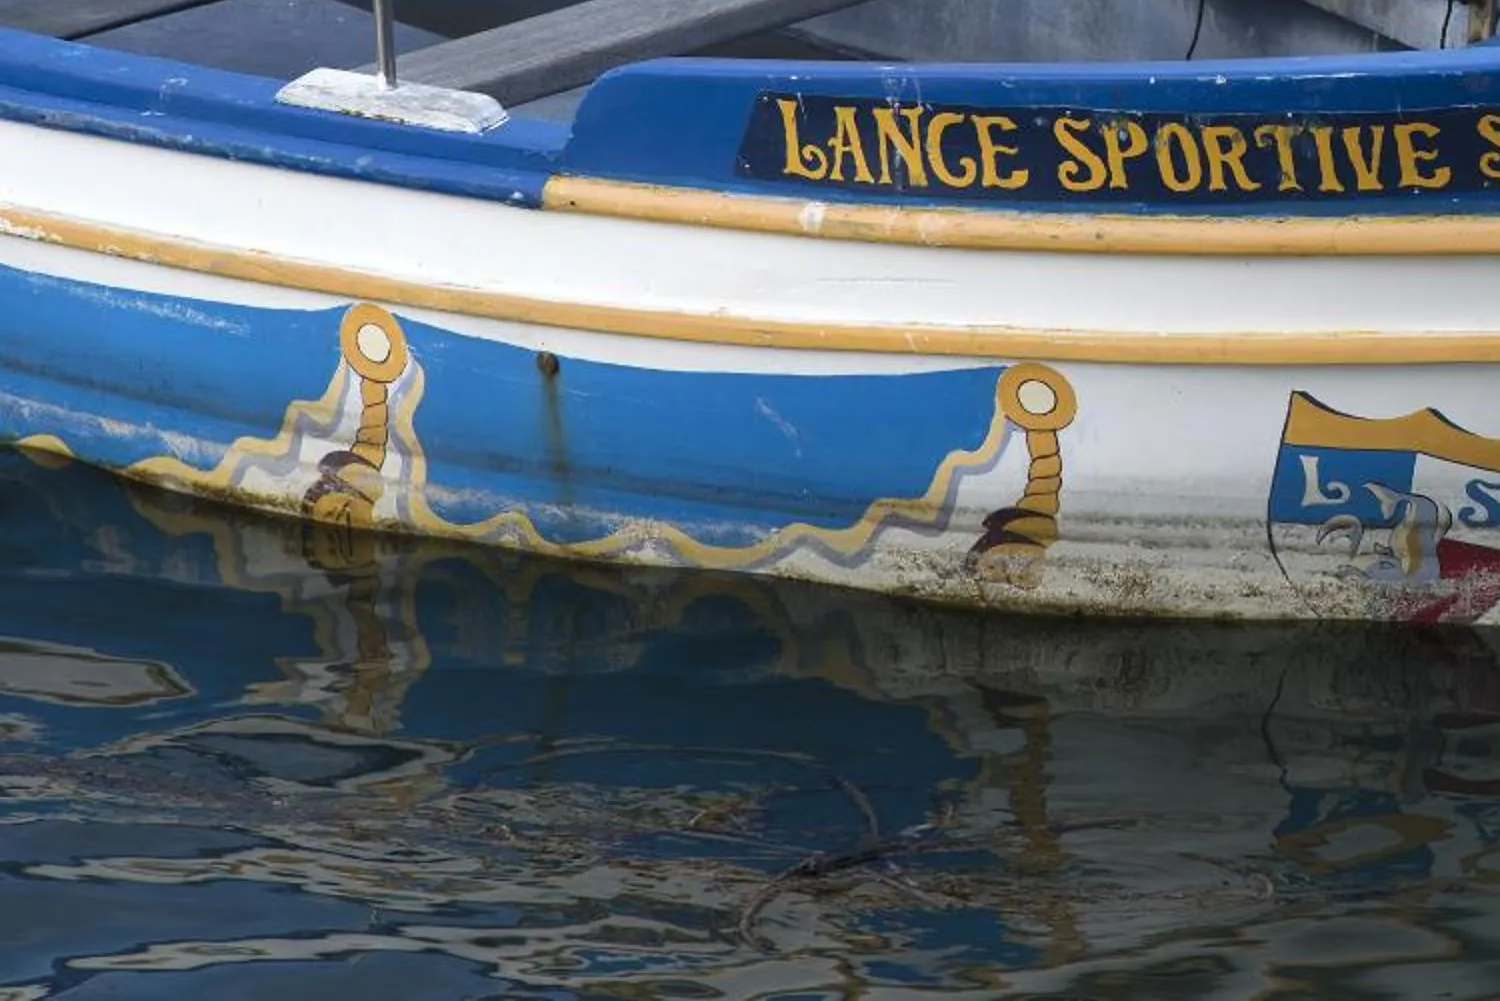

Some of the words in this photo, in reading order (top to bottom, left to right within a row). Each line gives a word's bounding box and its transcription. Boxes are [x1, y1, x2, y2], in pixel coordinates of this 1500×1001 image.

[776, 98, 1029, 190] LANCE
[1053, 117, 1453, 193] SPORTIVE
[1299, 454, 1351, 507] L
